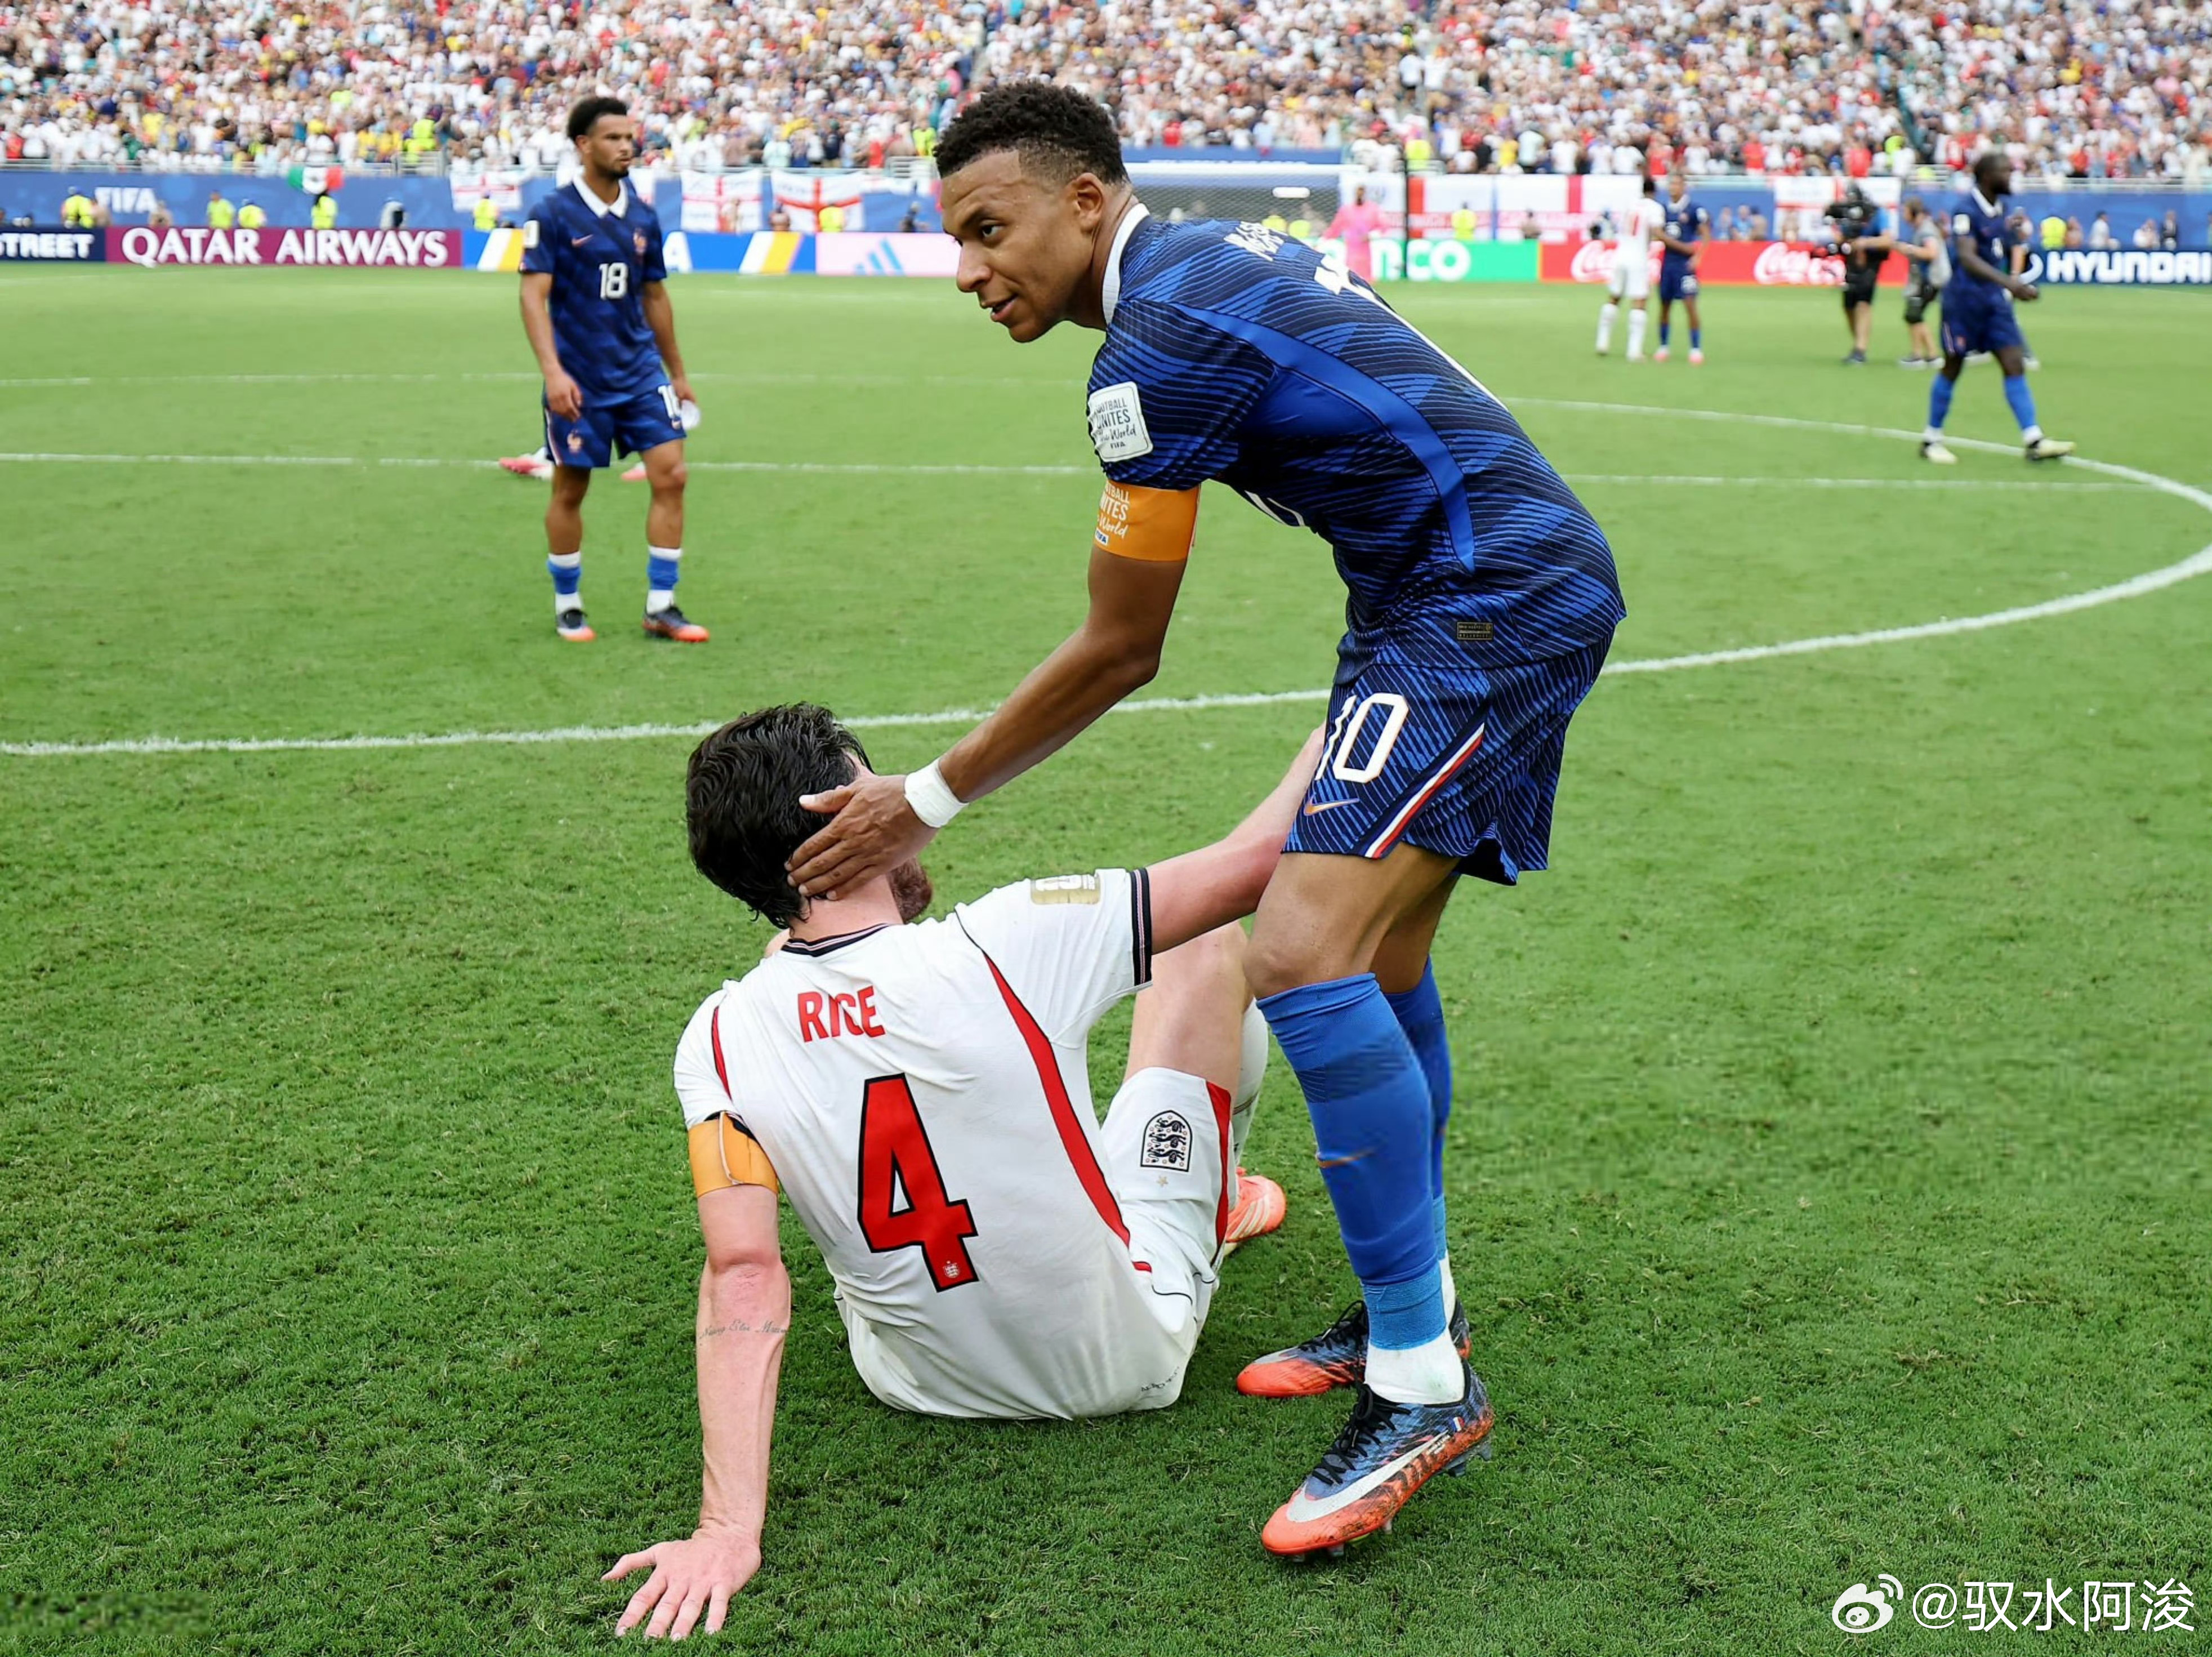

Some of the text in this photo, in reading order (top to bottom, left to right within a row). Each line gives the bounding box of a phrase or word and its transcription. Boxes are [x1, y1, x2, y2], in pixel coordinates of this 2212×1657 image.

[95, 187, 158, 213] FIFA
[0, 233, 95, 259] TREET
[122, 228, 448, 268] QATAR AIRWAYS
[599, 262, 629, 299] 18
[2046, 251, 2212, 283] HYUNDAI
[1110, 424, 1137, 440] World
[1315, 693, 1408, 783] 10
[797, 986, 885, 1043] RICE
[857, 1072, 979, 1293] 4
